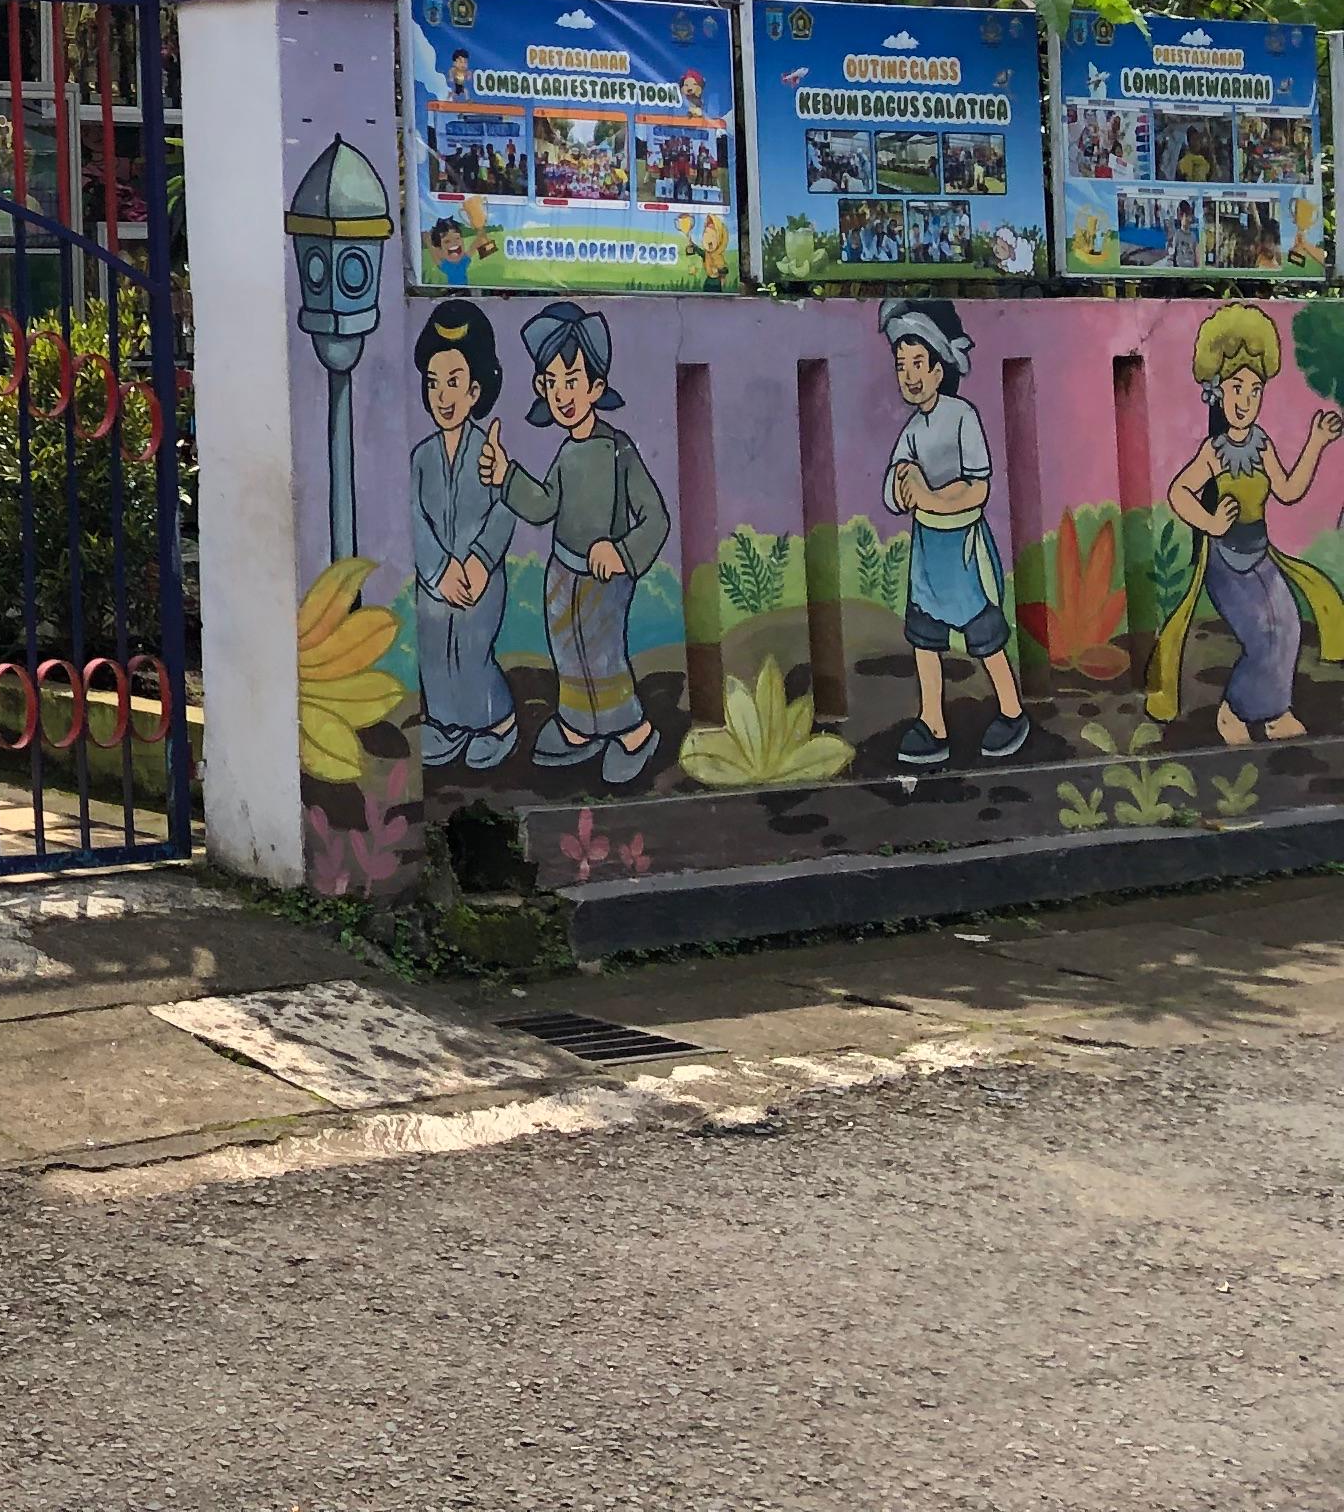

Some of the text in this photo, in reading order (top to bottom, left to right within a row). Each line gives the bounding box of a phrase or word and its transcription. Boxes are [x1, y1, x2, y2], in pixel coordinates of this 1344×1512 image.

[846, 58, 959, 81] OUTING CLASS
[477, 73, 680, 105] LOMBA LARI ESTAFET 100M
[1123, 71, 1271, 100] LOMBA MEWARNAI
[798, 91, 1008, 120] KEBUN BAGUS SALATIGA
[506, 240, 575, 259] GANESHA
[578, 242, 618, 261] OPEN
[638, 245, 677, 263] 2025
